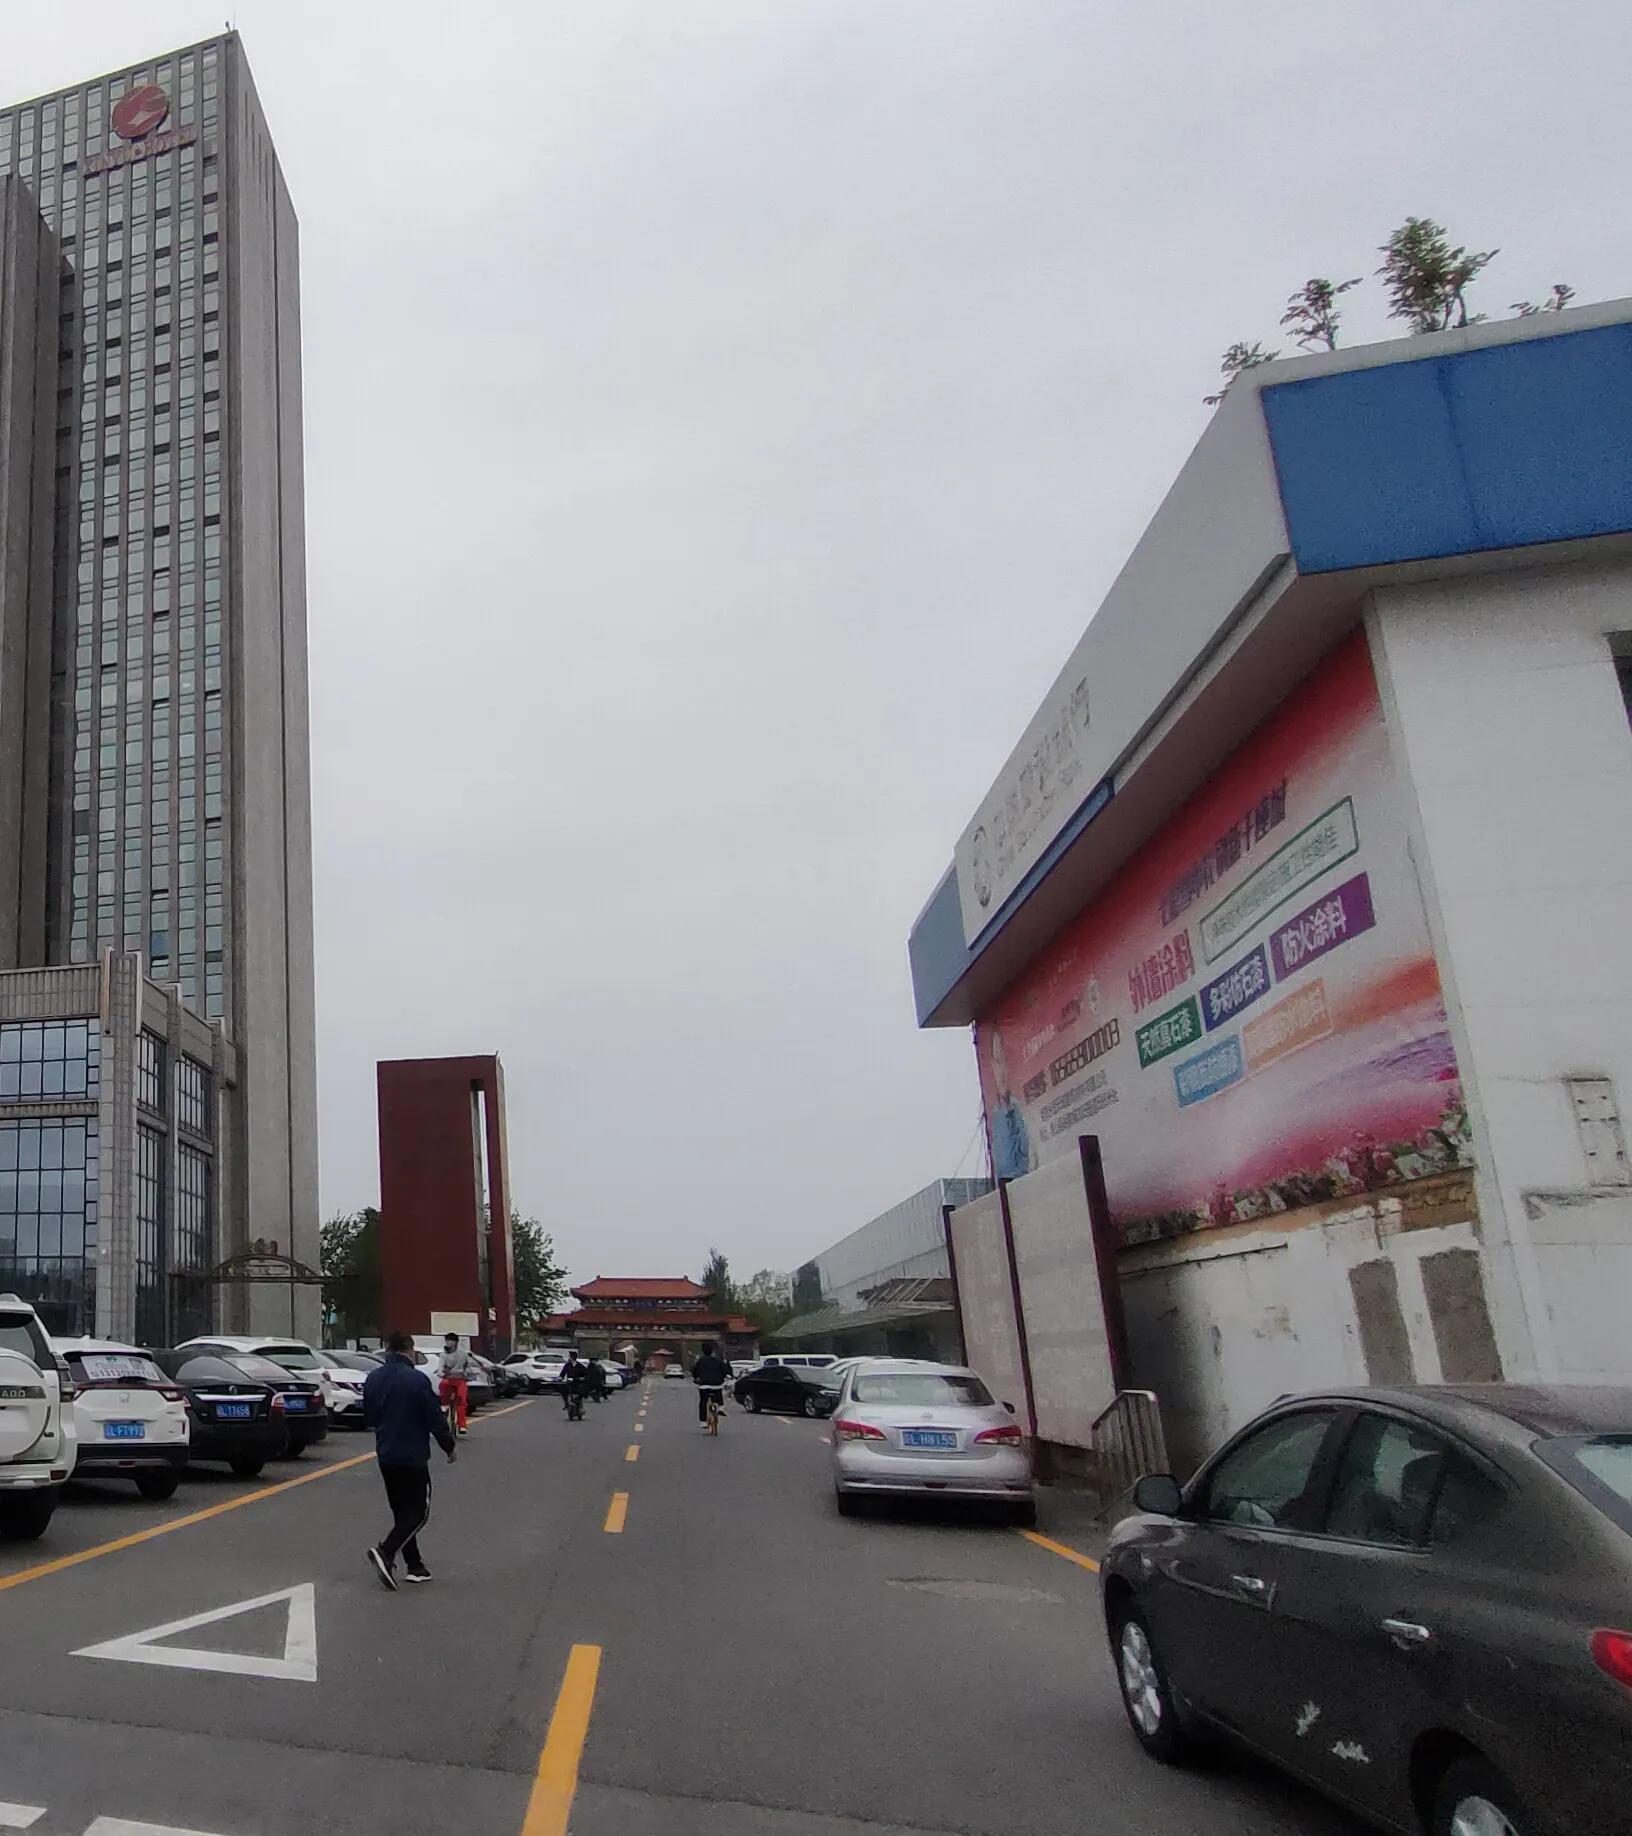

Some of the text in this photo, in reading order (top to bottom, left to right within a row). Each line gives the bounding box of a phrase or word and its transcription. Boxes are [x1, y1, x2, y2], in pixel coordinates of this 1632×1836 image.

[1279, 895, 1347, 969] 防火涂料
[1209, 955, 1264, 1021] 多彩仿石漆
